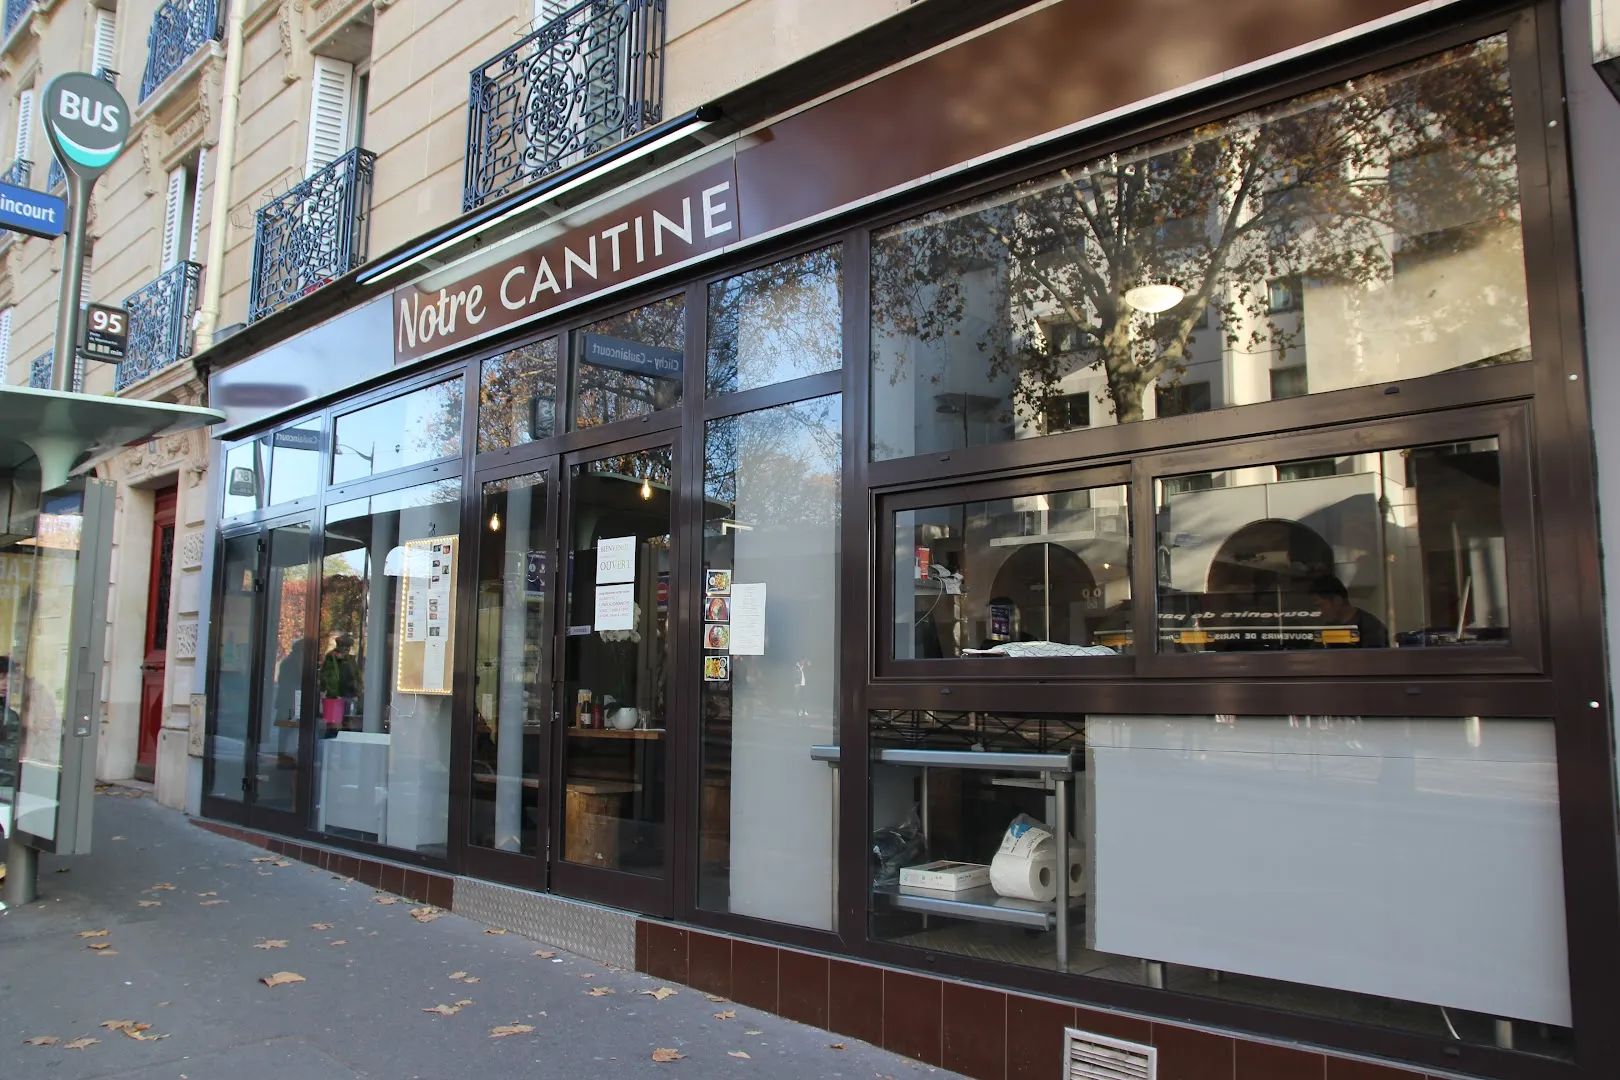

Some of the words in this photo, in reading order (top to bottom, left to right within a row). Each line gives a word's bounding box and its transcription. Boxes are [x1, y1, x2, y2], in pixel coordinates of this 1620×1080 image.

[60, 89, 119, 133] BUS
[0, 193, 56, 224] incourt
[398, 284, 486, 352] Notre
[500, 181, 732, 310] CANTINE
[93, 310, 122, 334] 95
